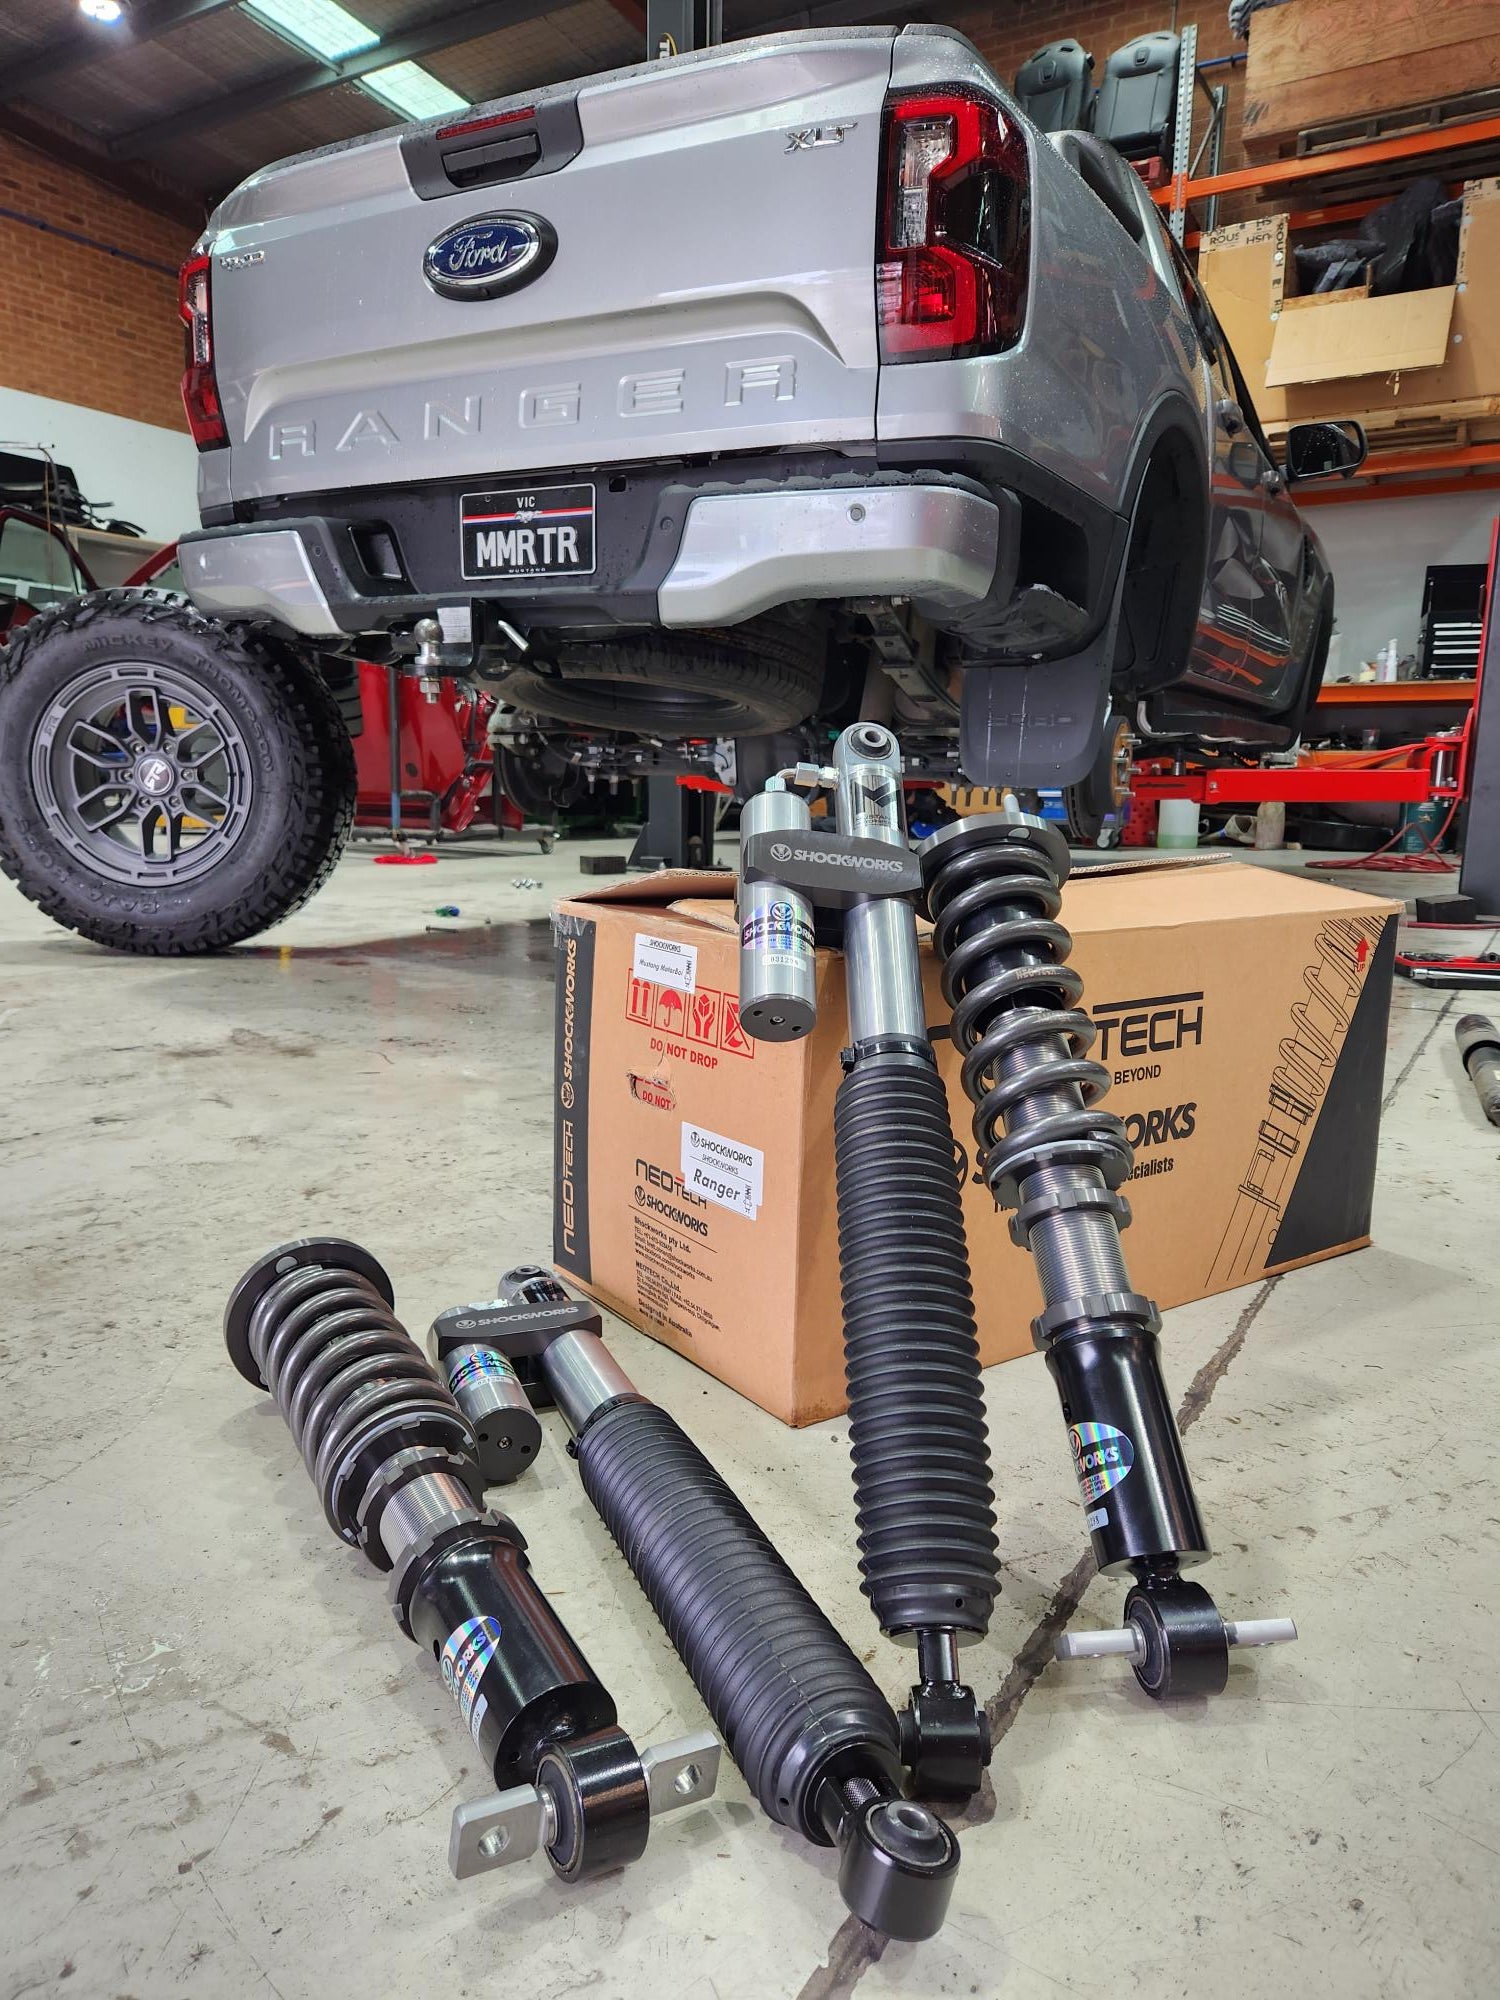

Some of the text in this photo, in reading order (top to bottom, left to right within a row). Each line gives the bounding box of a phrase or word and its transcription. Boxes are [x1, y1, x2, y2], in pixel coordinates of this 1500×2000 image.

[784, 122, 858, 154] XLT
[448, 230, 509, 271] Ford
[268, 354, 798, 461] RANGER
[516, 496, 537, 508] VIC
[476, 525, 580, 568] MMRTR
[84, 633, 275, 773] MICKEY THOMPSON
[793, 849, 904, 873] SHOCKWORKS
[563, 938, 577, 1081] SHOCKWORKS
[650, 1038, 718, 1070] DO NOT DROP
[1114, 1064, 1162, 1085] BEYOND
[642, 1090, 672, 1110] DO NOT
[700, 1137, 754, 1168] SHOCKWORKS
[702, 1153, 739, 1175] SHOCKWORKS
[693, 1168, 741, 1201] Ranger
[1122, 1157, 1174, 1181] ecialists
[563, 1119, 576, 1256] NEOTECH
[646, 1194, 709, 1237] SHOCKWORKS
[477, 1306, 580, 1327] SHOCKWORKS
